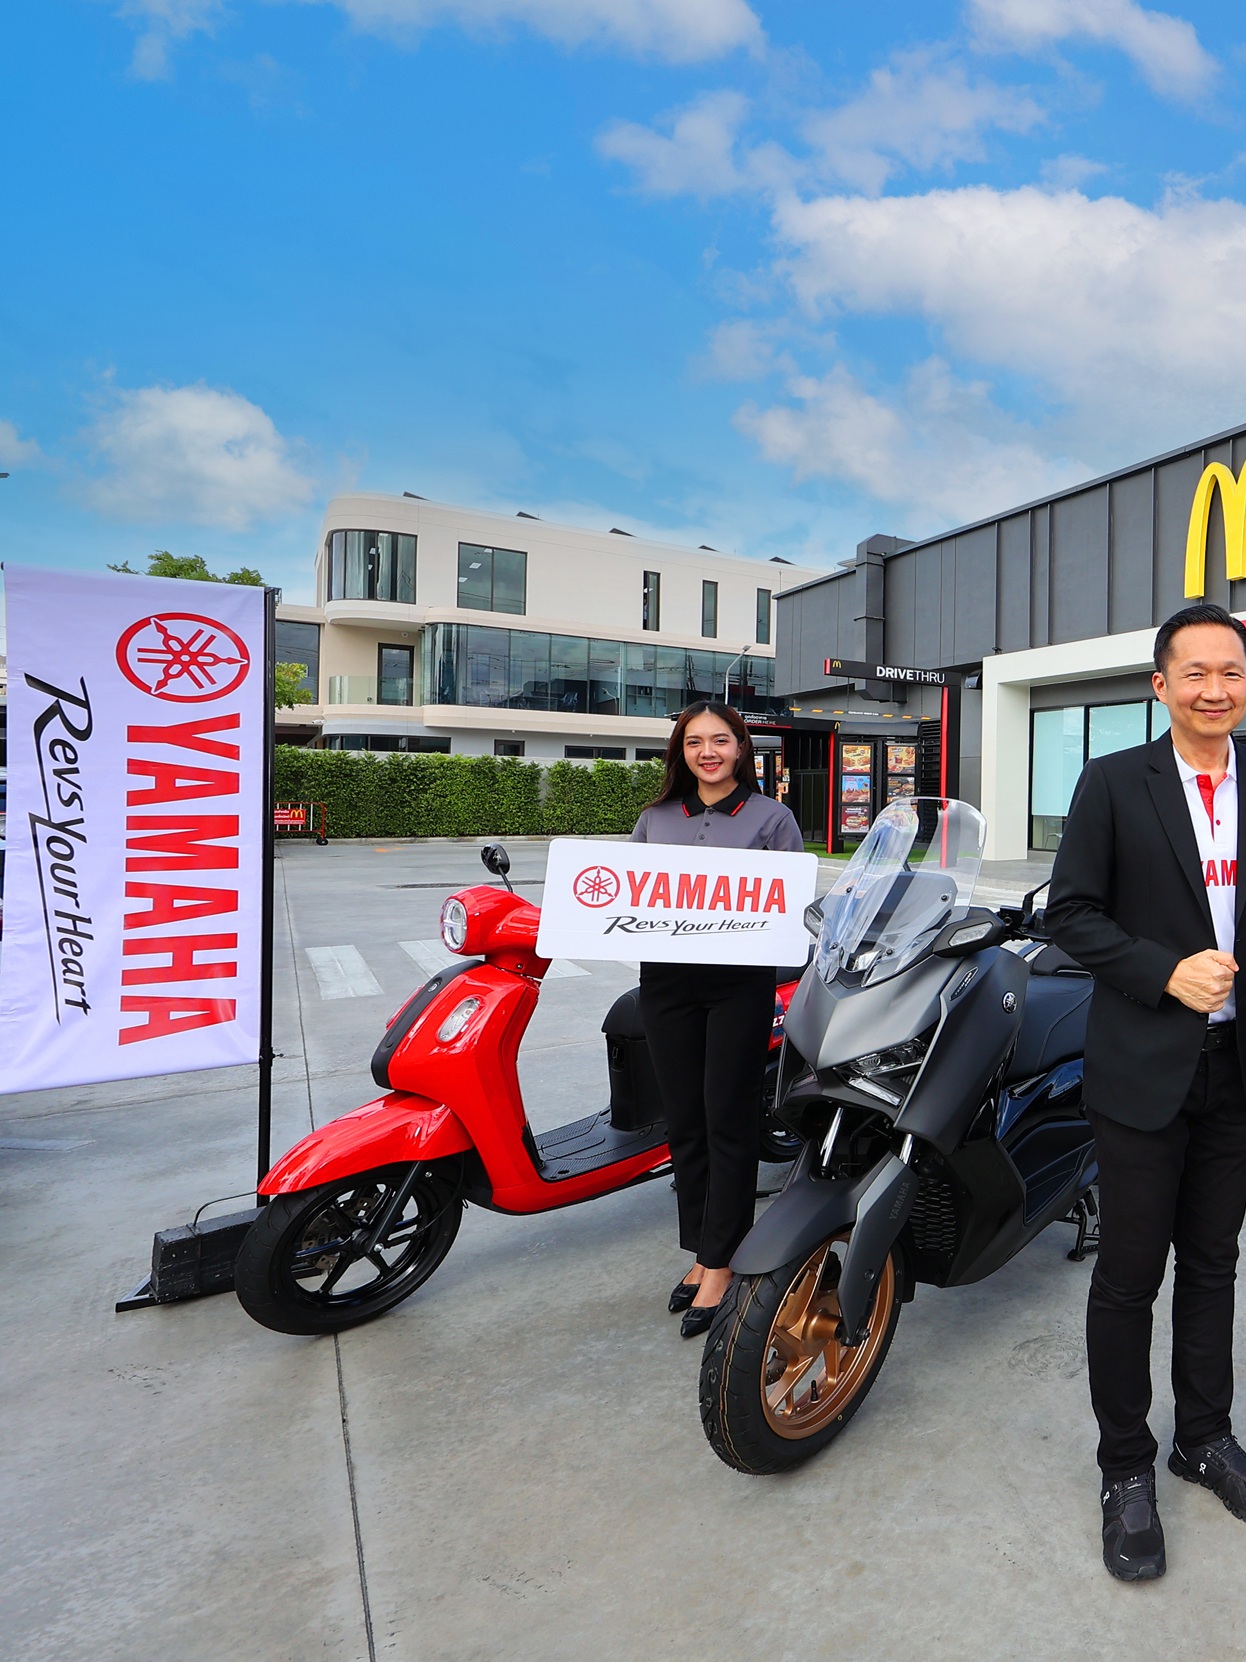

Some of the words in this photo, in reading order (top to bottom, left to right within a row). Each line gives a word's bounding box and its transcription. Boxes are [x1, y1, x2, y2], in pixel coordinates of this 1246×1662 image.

[23, 672, 94, 812] Revs
[28, 811, 89, 915] Your
[118, 711, 241, 1046] YAMAHA
[627, 870, 786, 914] YAMAHA
[1200, 859, 1238, 887] AM
[603, 915, 670, 936] Revs
[671, 918, 720, 936] Your
[719, 919, 769, 931] Heart
[56, 914, 95, 1017] Heart
[889, 1182, 911, 1220] YAMAHA
